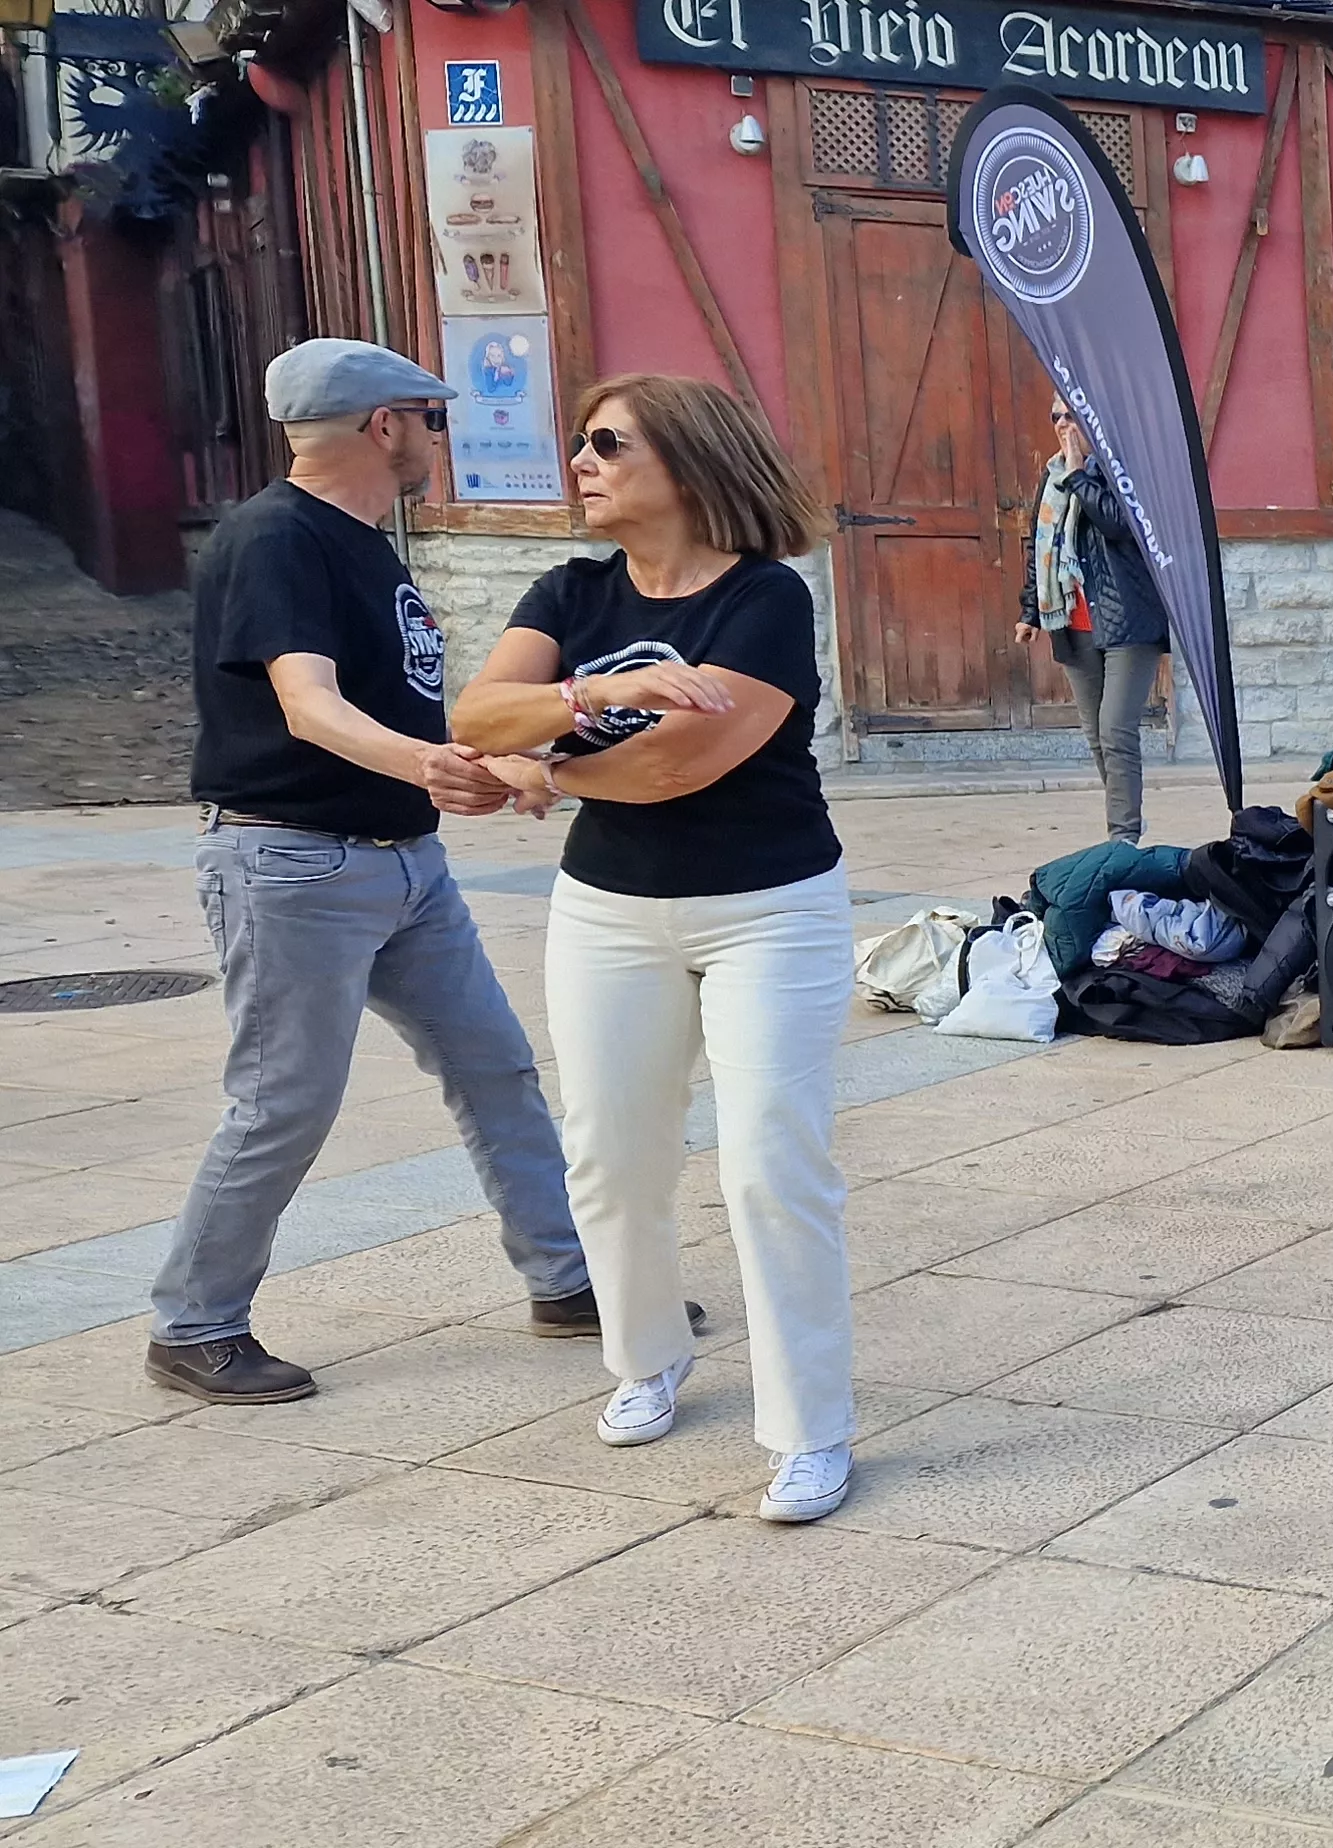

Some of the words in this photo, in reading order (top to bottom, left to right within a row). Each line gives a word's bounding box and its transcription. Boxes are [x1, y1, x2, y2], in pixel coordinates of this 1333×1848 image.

[663, 0, 750, 50] El
[800, 0, 957, 71] Viejo
[999, 11, 1250, 95] Acordeon
